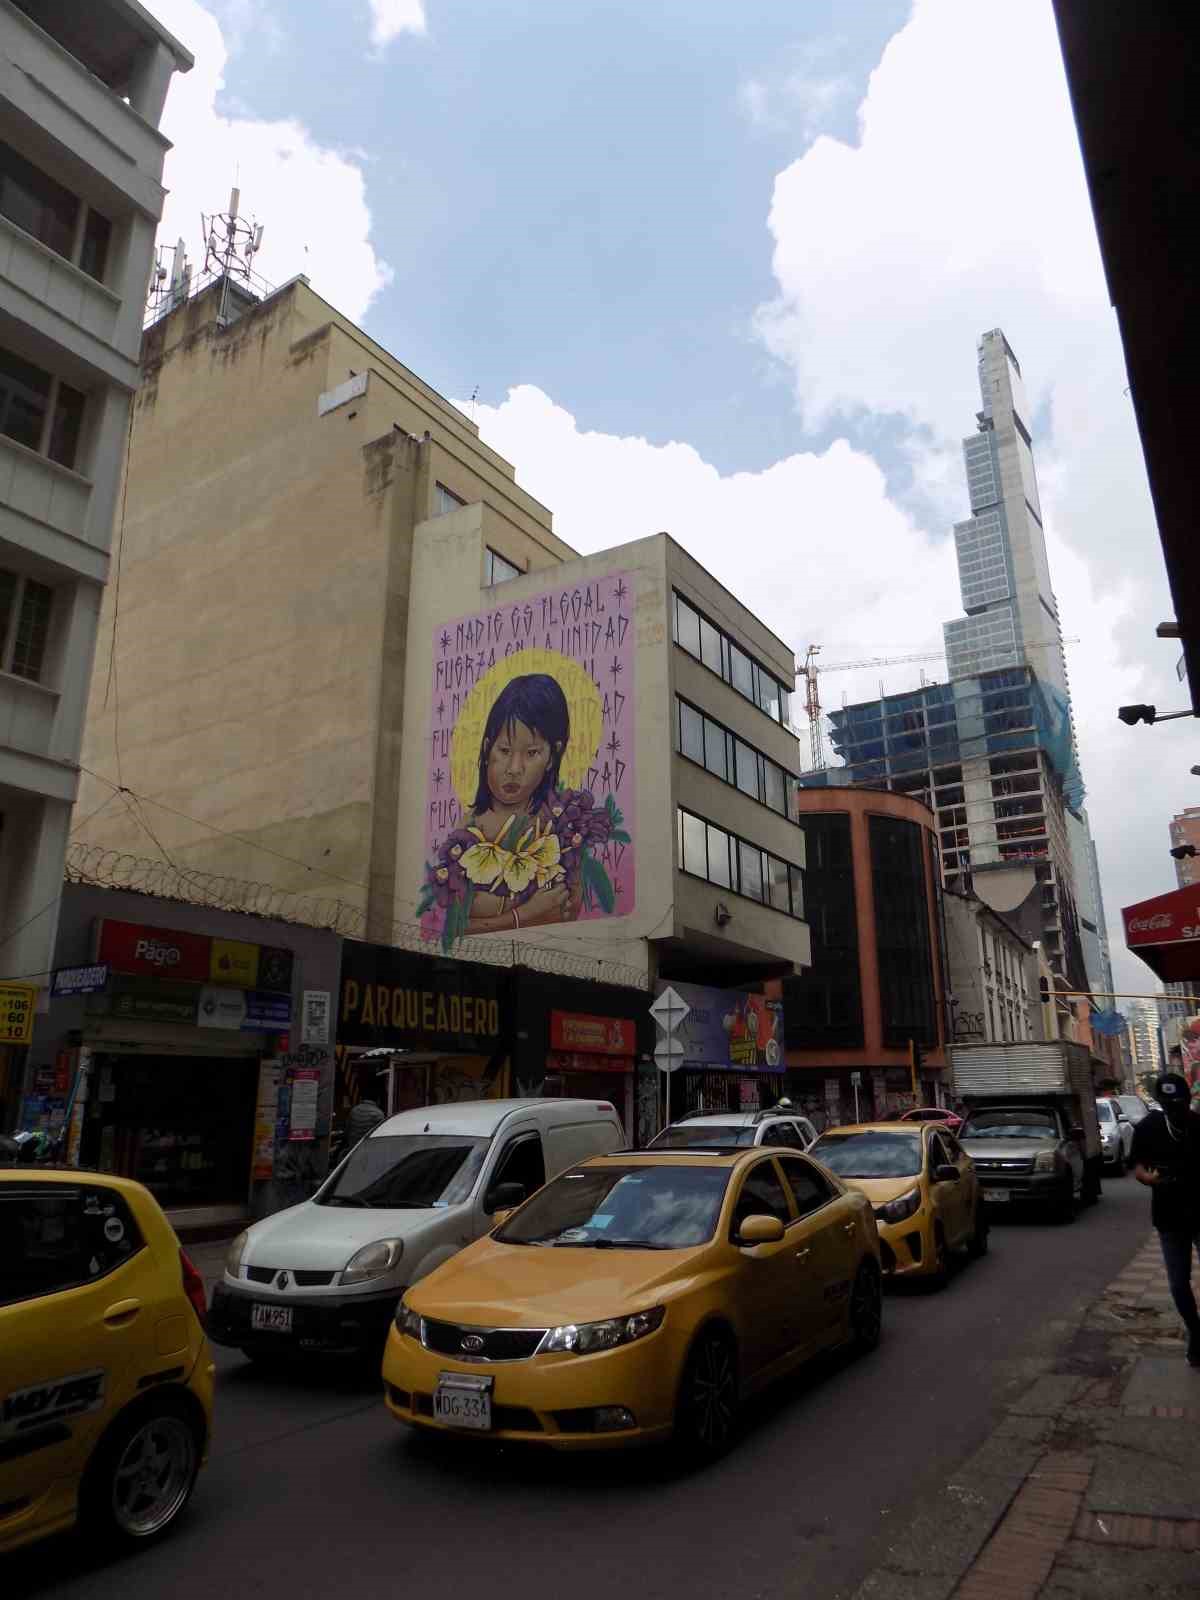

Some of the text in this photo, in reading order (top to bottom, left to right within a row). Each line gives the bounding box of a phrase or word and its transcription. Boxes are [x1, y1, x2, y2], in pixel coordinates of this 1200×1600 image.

[1127, 911, 1175, 934] Coca-Cola
[135, 939, 181, 967] Pago
[341, 979, 500, 1037] PARQUEADERO
